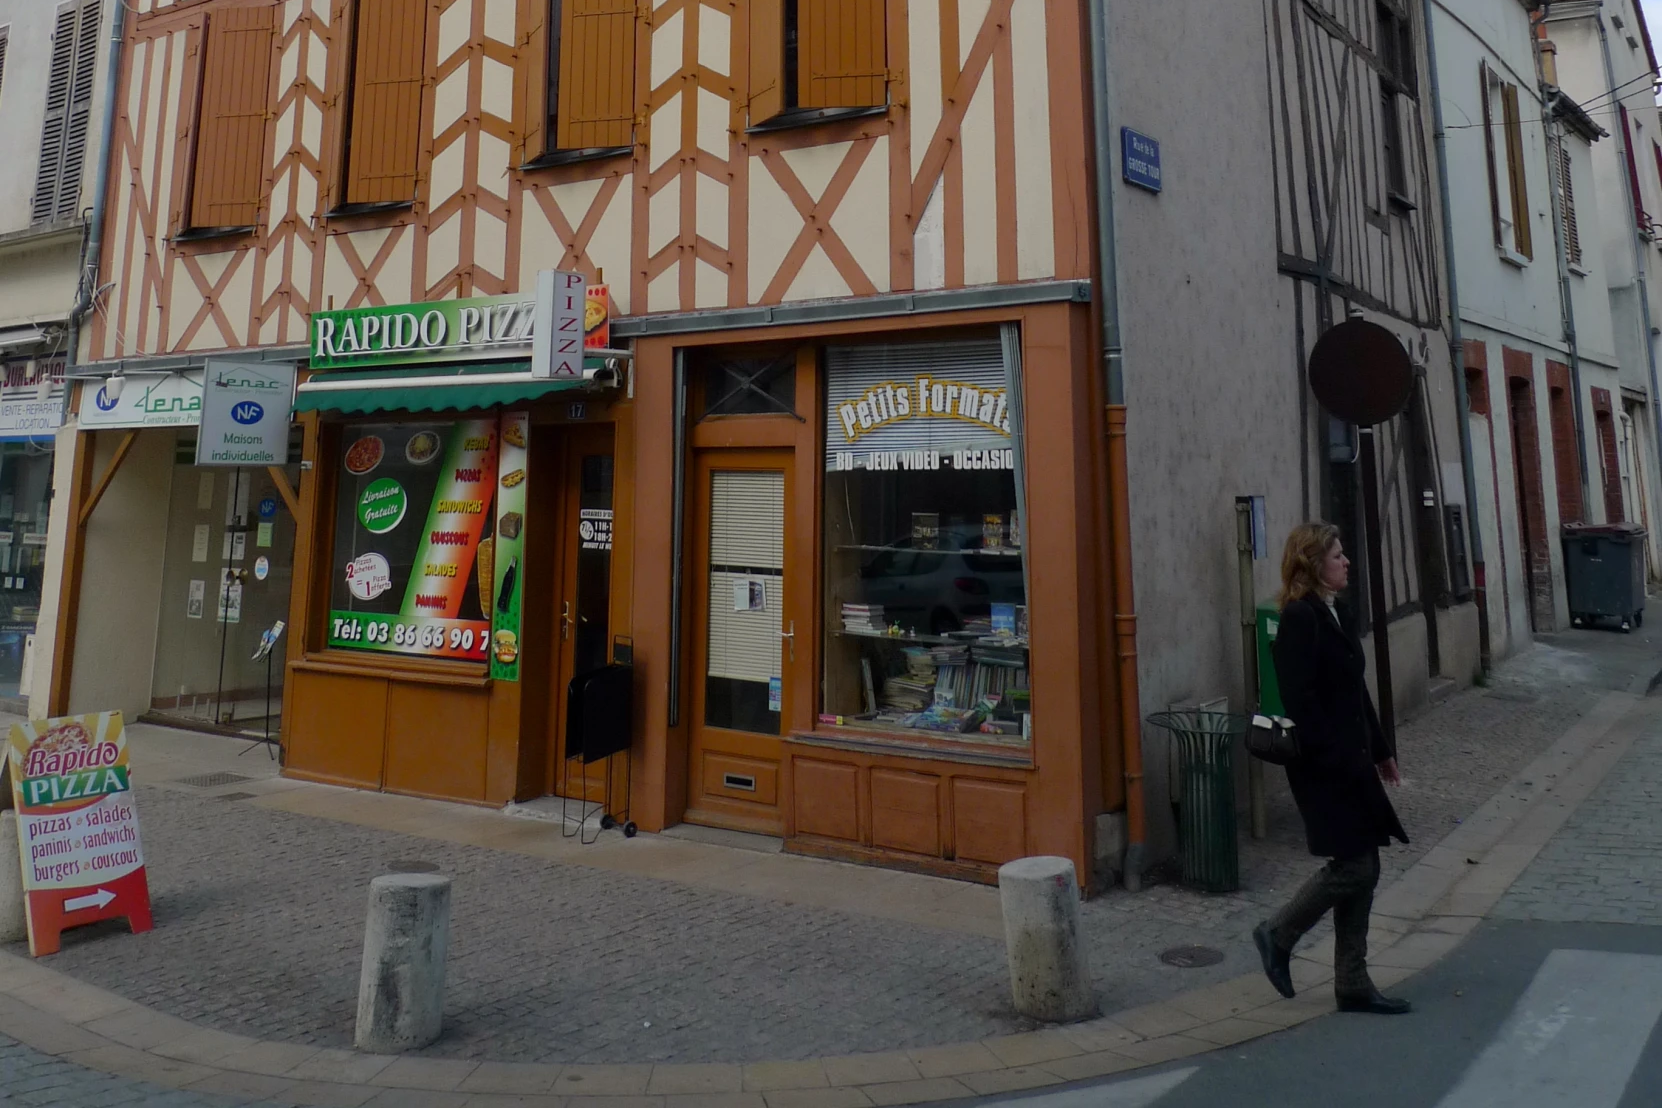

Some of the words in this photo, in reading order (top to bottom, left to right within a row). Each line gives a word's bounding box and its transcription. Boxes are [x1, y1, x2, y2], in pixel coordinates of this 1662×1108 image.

[315, 309, 447, 357] RAPIDO
[555, 274, 582, 376] PIZZA
[237, 405, 260, 420] NF
[571, 404, 583, 418] 17
[840, 384, 910, 438] Petits
[15, 419, 50, 430] LOCATION
[224, 433, 263, 445] Maisons
[464, 436, 490, 451] KEBAB
[212, 450, 274, 461] individuelles
[836, 451, 854, 471] BD
[866, 450, 898, 471] JEUX
[455, 468, 482, 483] PIZZAS
[361, 486, 400, 505] Livraison
[365, 504, 398, 524] Gratuite
[437, 499, 483, 514] SANDWICHS
[431, 530, 469, 546] COUSCOUS
[348, 564, 354, 579] 2
[424, 563, 458, 578] SALADES
[366, 581, 371, 596] 1
[334, 619, 361, 641] Tél:
[367, 621, 389, 643] 03
[394, 623, 416, 645] 86
[421, 625, 444, 648] 66
[450, 627, 474, 650] 90
[28, 741, 119, 778] Rapido
[31, 769, 125, 805] PIZZA
[29, 815, 72, 839] pizzas
[86, 805, 132, 827] salades
[32, 838, 72, 862] paninis
[82, 826, 136, 850] sandwichs
[35, 859, 80, 881] burgers
[91, 849, 138, 871] couscous
